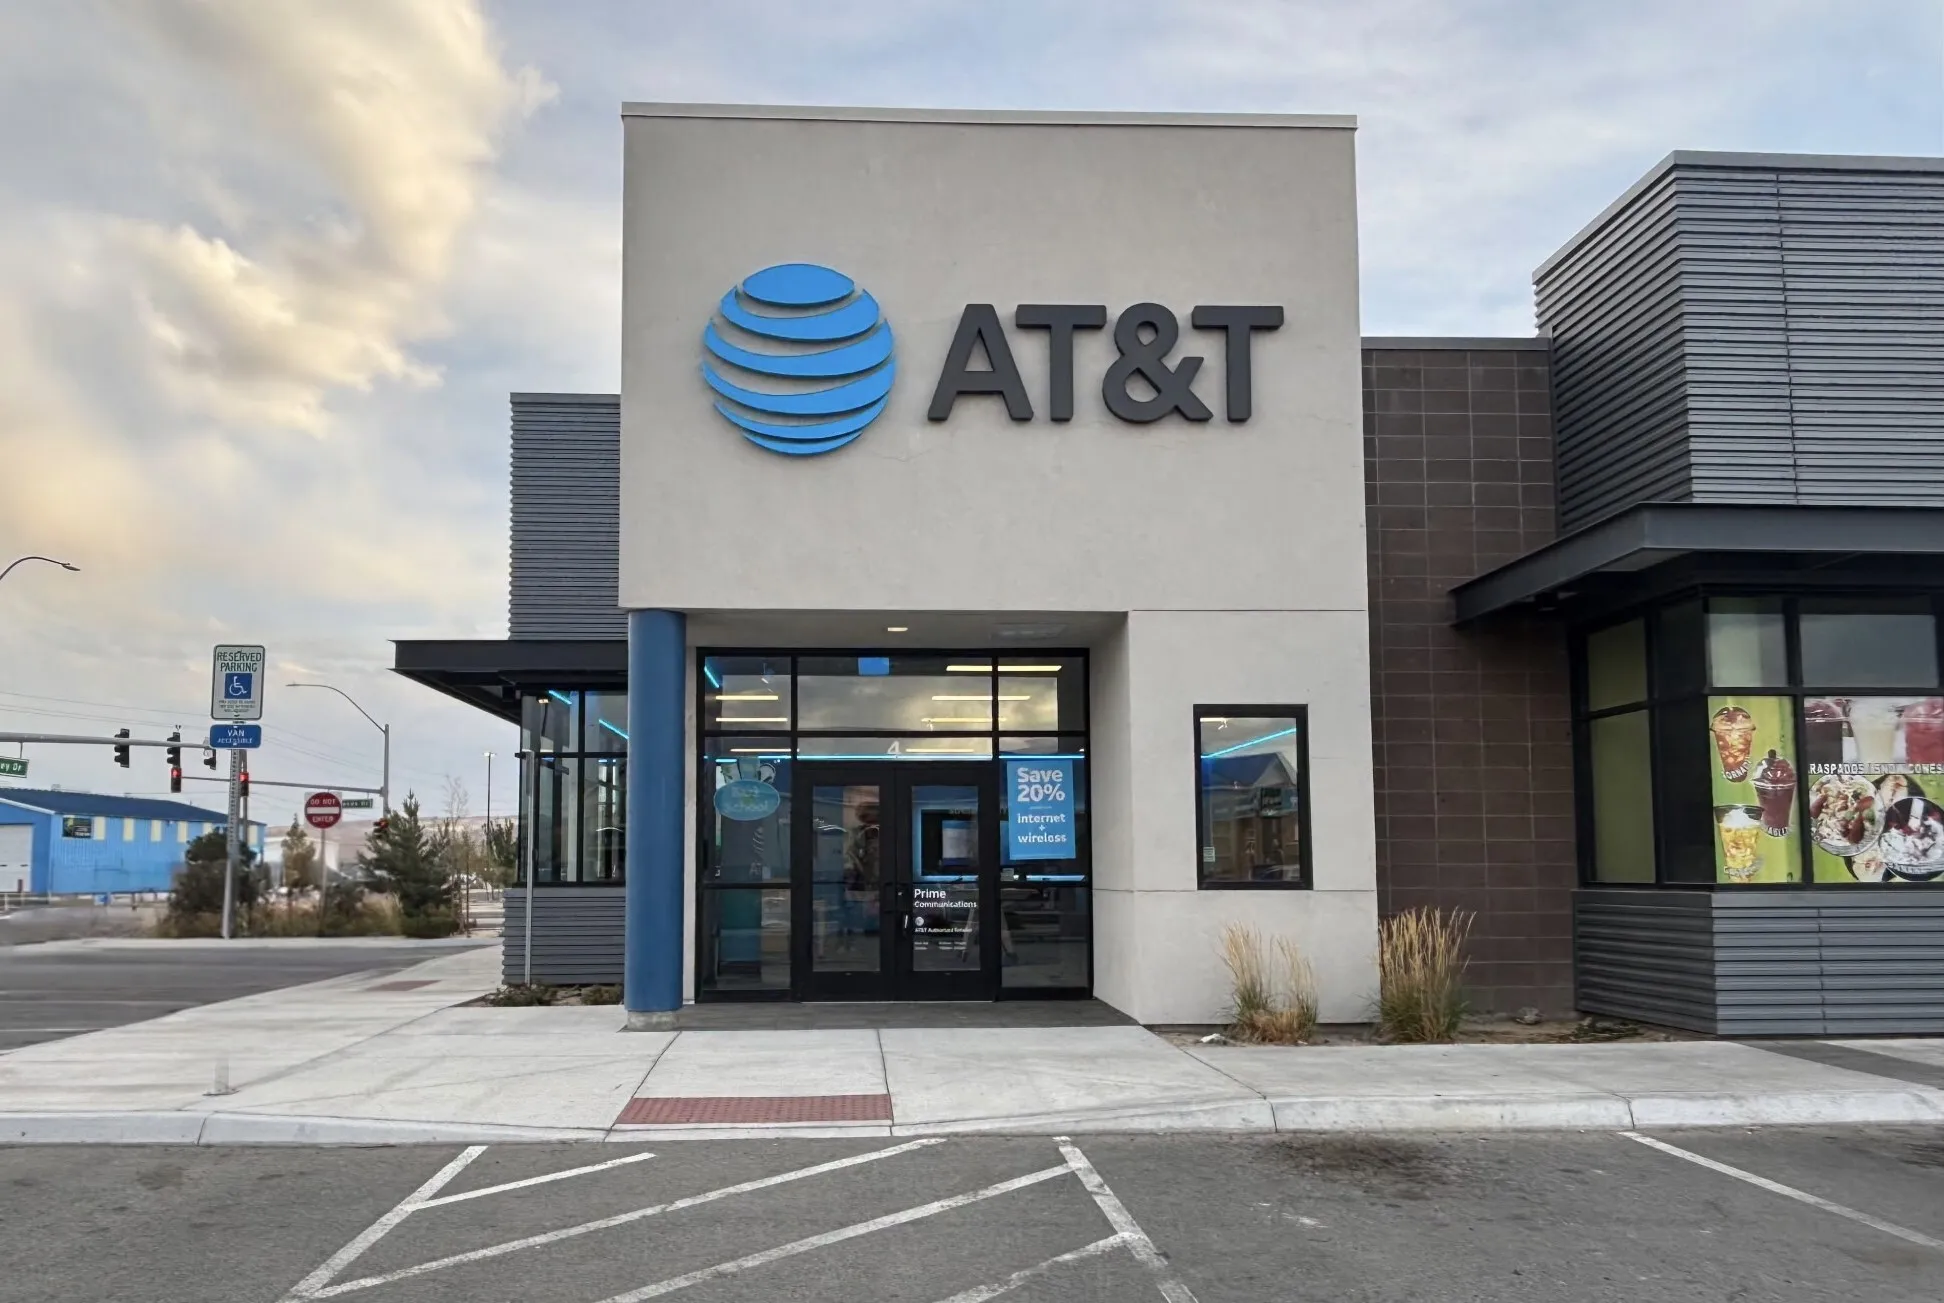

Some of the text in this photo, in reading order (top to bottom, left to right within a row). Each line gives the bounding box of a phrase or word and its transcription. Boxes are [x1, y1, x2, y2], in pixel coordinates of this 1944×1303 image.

[927, 302, 1285, 424] AT&T
[216, 651, 262, 662] RESERVED
[220, 661, 258, 673] PARKING
[227, 728, 245, 737] VAN
[886, 740, 901, 759] 4
[1017, 766, 1064, 783] Save
[1808, 763, 1865, 775] RASPADOS
[1907, 763, 1944, 775] CONES
[1017, 783, 1067, 802] 20%
[312, 815, 334, 823] ENTER
[1016, 813, 1067, 824] internet
[1017, 832, 1068, 843] wireless
[914, 888, 947, 899] Prime
[914, 900, 978, 908] Communications
